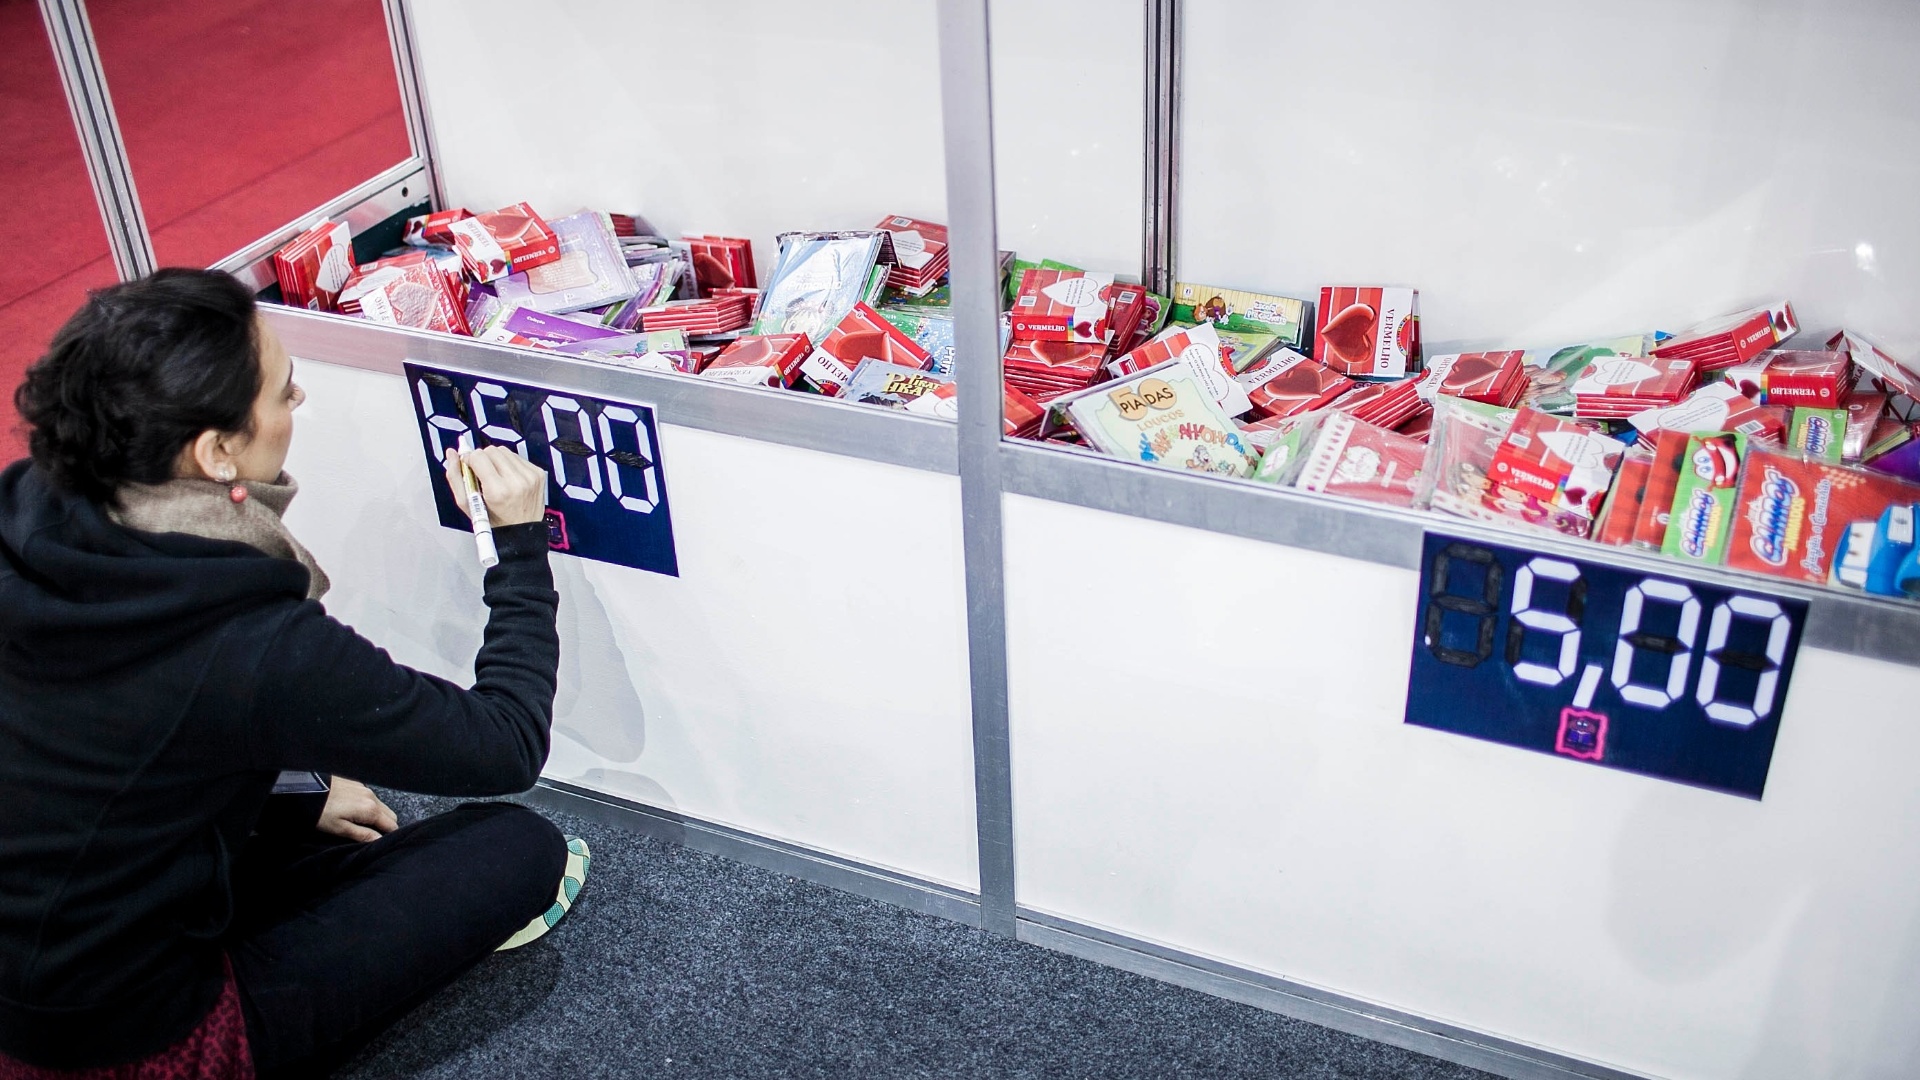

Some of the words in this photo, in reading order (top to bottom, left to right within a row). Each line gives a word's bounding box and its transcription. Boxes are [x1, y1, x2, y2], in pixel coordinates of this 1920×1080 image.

[513, 249, 547, 264] VERMELHO
[1027, 323, 1066, 332] VERMELHO
[1380, 308, 1395, 369] VERMELHO
[1746, 325, 1771, 344] VERMELHO
[783, 352, 805, 376] VERMELHO
[817, 355, 850, 383] MELHO
[1248, 354, 1297, 386] VERMELHO
[1119, 387, 1174, 414] PIADAS
[1771, 388, 1816, 398] VERMELHO
[1136, 408, 1186, 432] LOUCOS
[1510, 466, 1556, 491] VERMELHO
[1752, 470, 1797, 564] CARROS
[1784, 495, 1806, 551] ANIMADOS
[1510, 556, 1793, 729] 5,00
